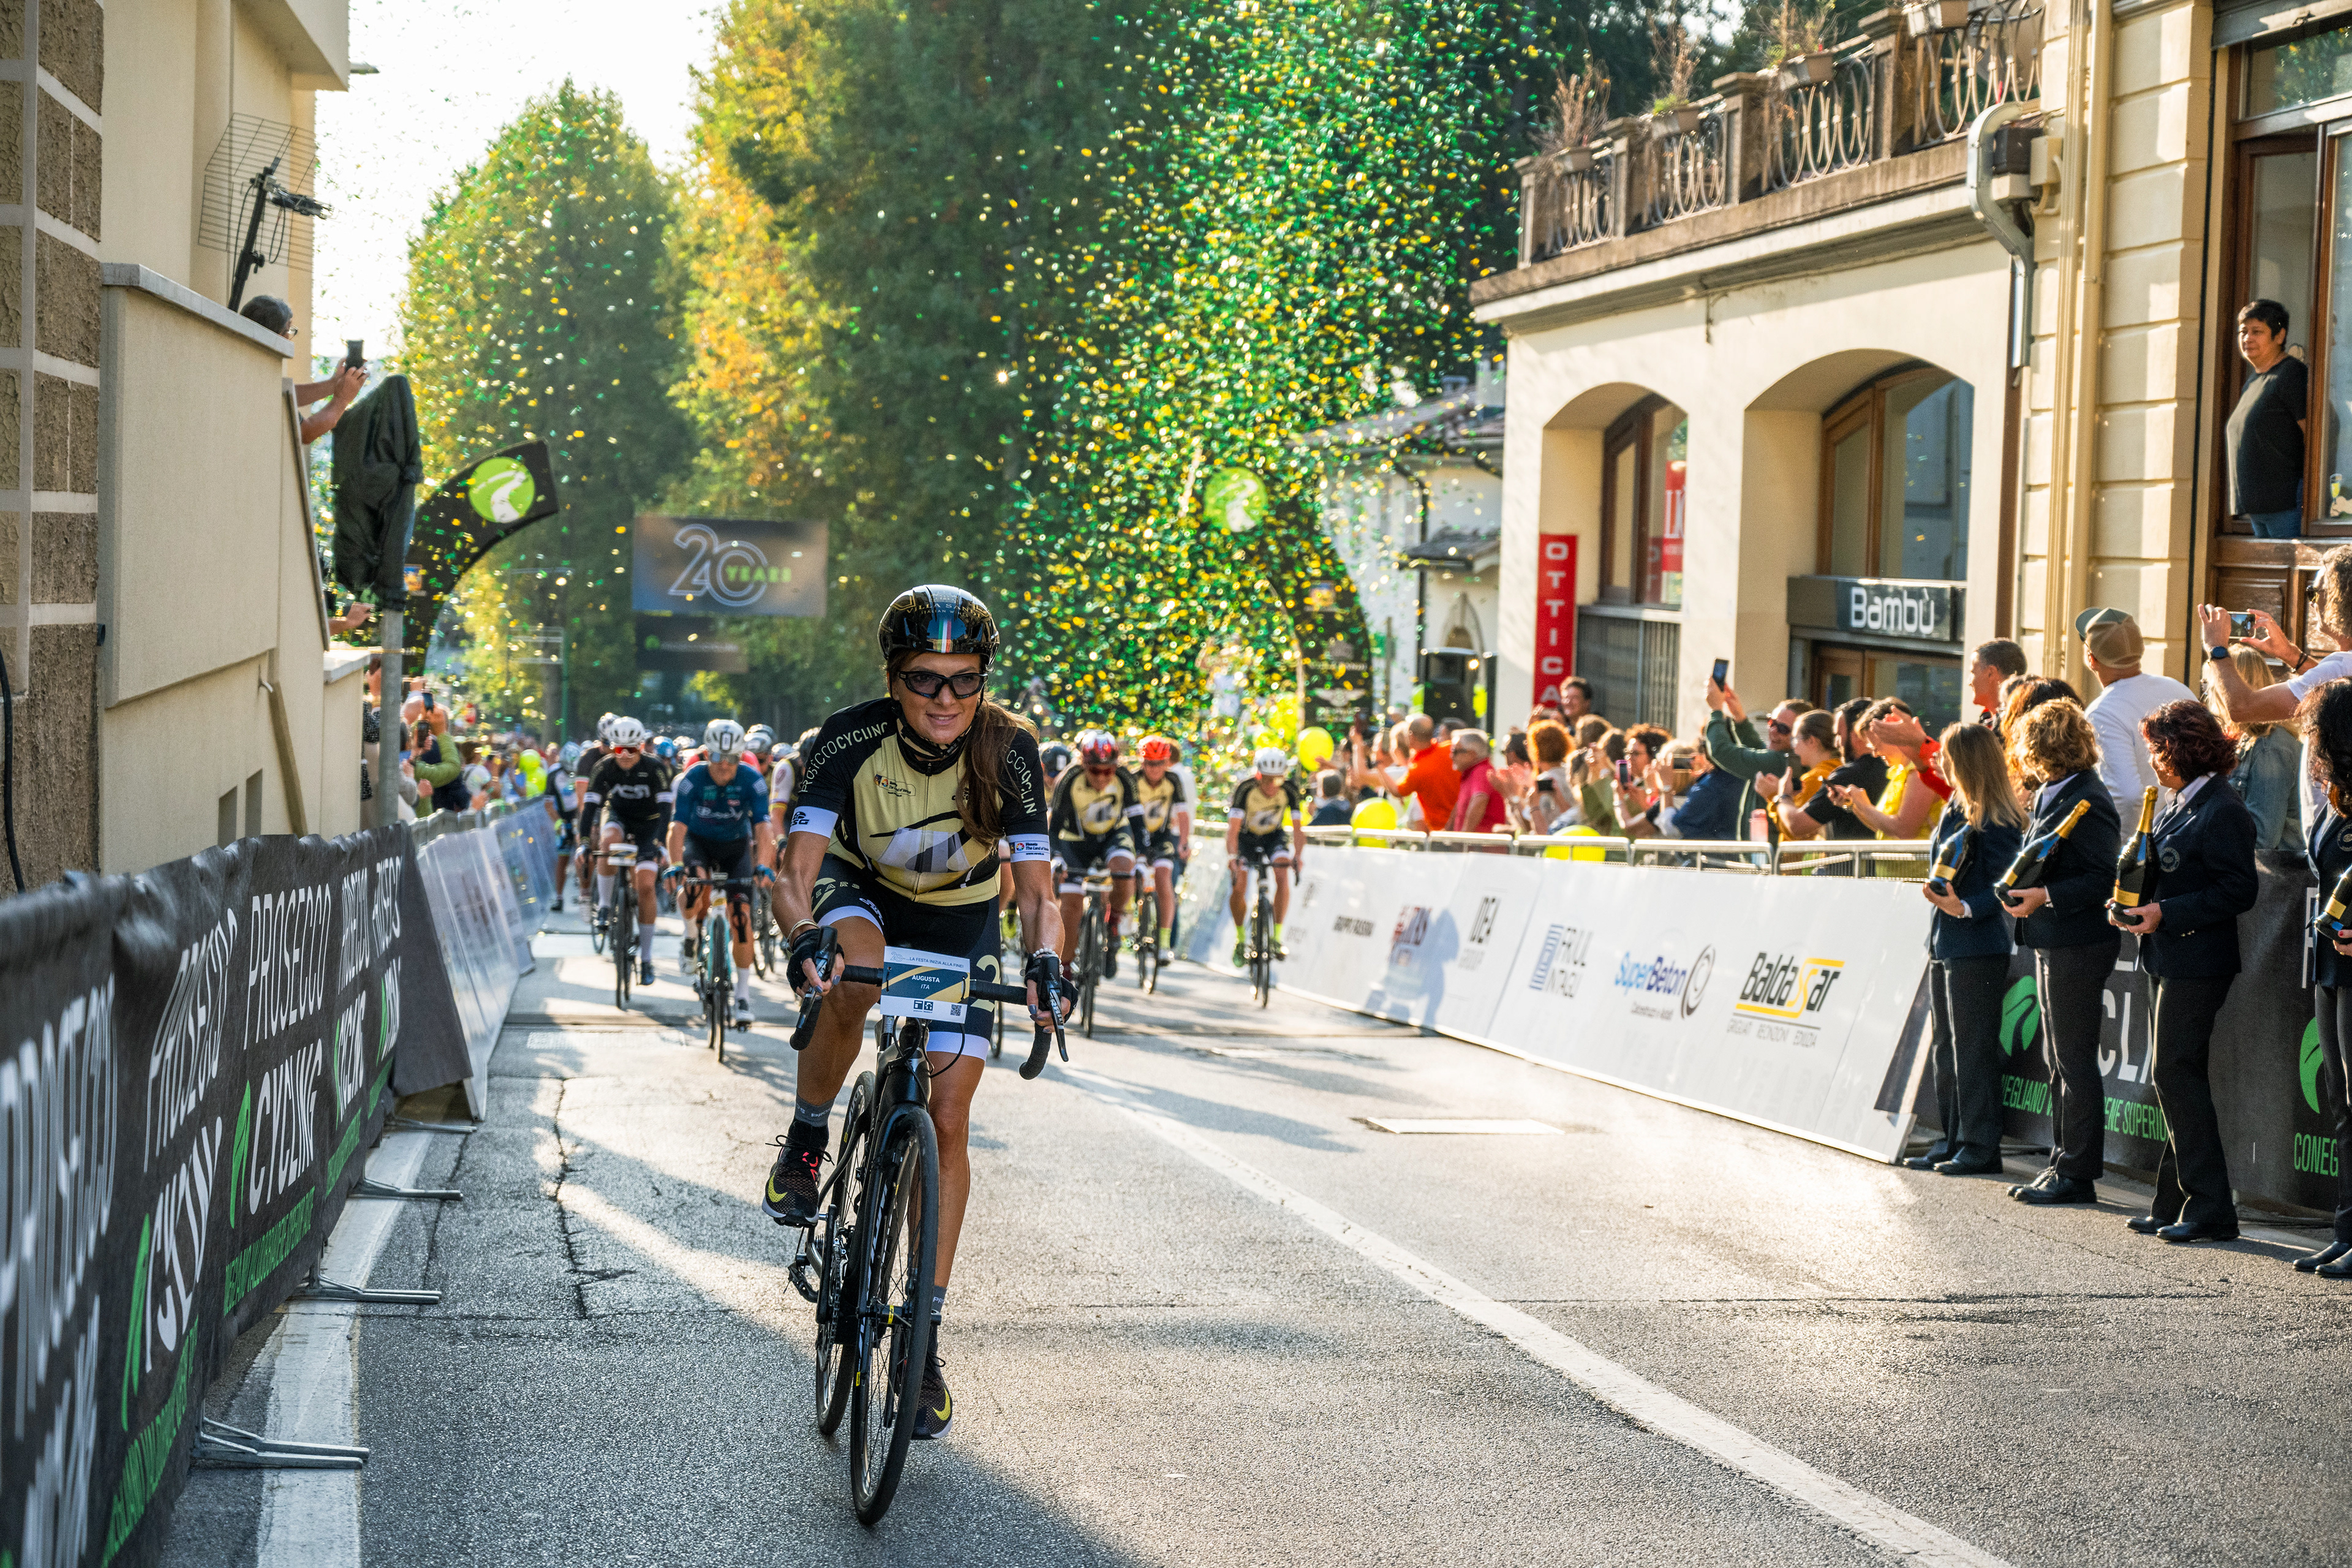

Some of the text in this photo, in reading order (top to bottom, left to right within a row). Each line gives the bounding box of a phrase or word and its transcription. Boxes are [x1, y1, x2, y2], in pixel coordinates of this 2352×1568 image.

[726, 566, 791, 582] YEARS
[907, 603, 941, 614] VILLA
[1540, 541, 1569, 703] OTTICA
[1851, 587, 1934, 635] Bambù
[243, 883, 331, 1050] PROSECCO
[911, 974, 940, 983] AUGUSTA
[249, 1038, 322, 1215] CYCLING
